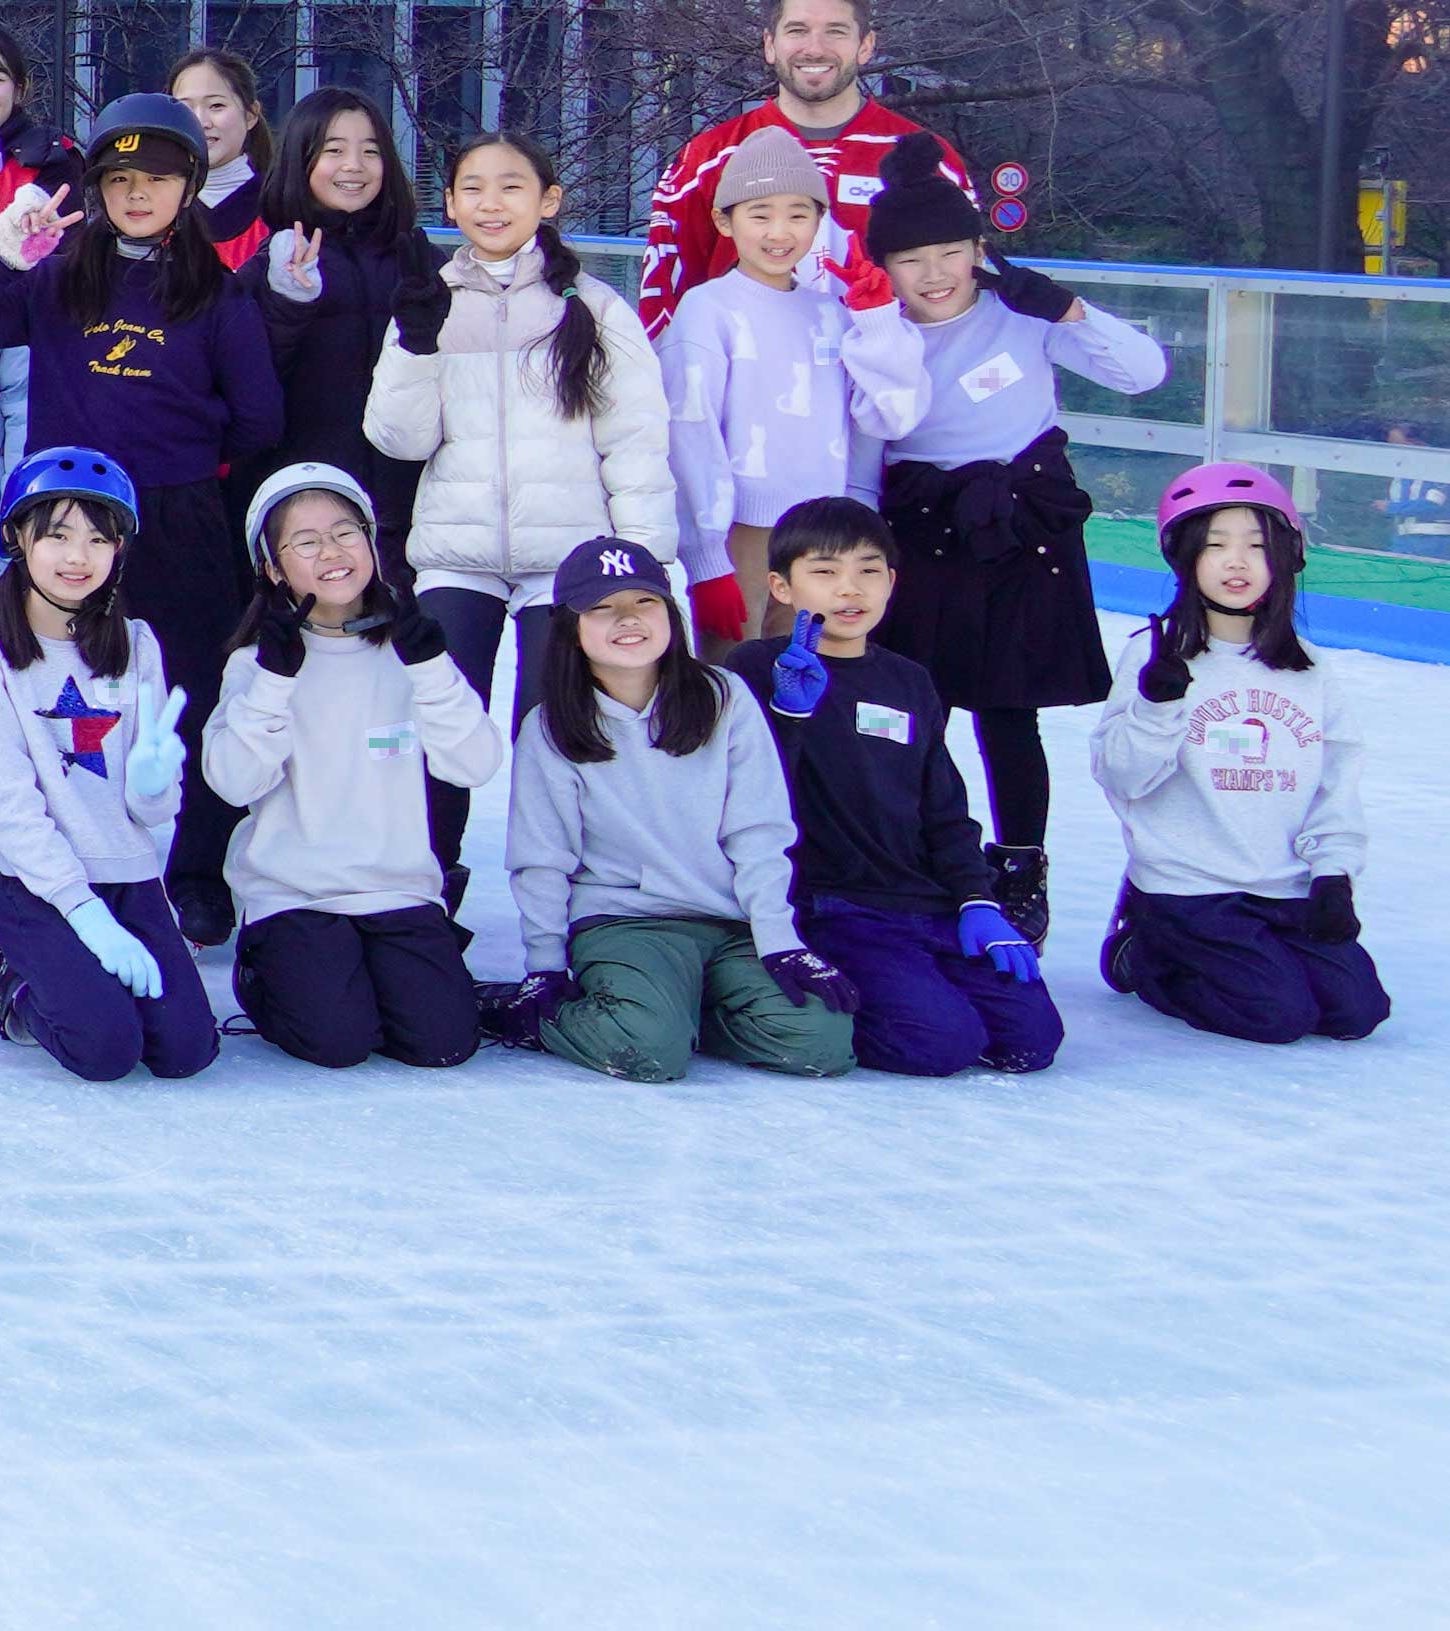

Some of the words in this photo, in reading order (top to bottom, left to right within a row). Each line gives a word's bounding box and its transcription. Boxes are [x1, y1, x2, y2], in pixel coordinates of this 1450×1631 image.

[1000, 173, 1020, 187] 30
[639, 244, 683, 299] 27
[112, 319, 146, 334] Jeans
[89, 361, 122, 376] Track
[122, 367, 152, 378] team
[599, 549, 635, 576] NY
[1185, 689, 1240, 746] COURT
[1246, 687, 1322, 748] HUSTLE
[1210, 768, 1274, 792] CHAMPS
